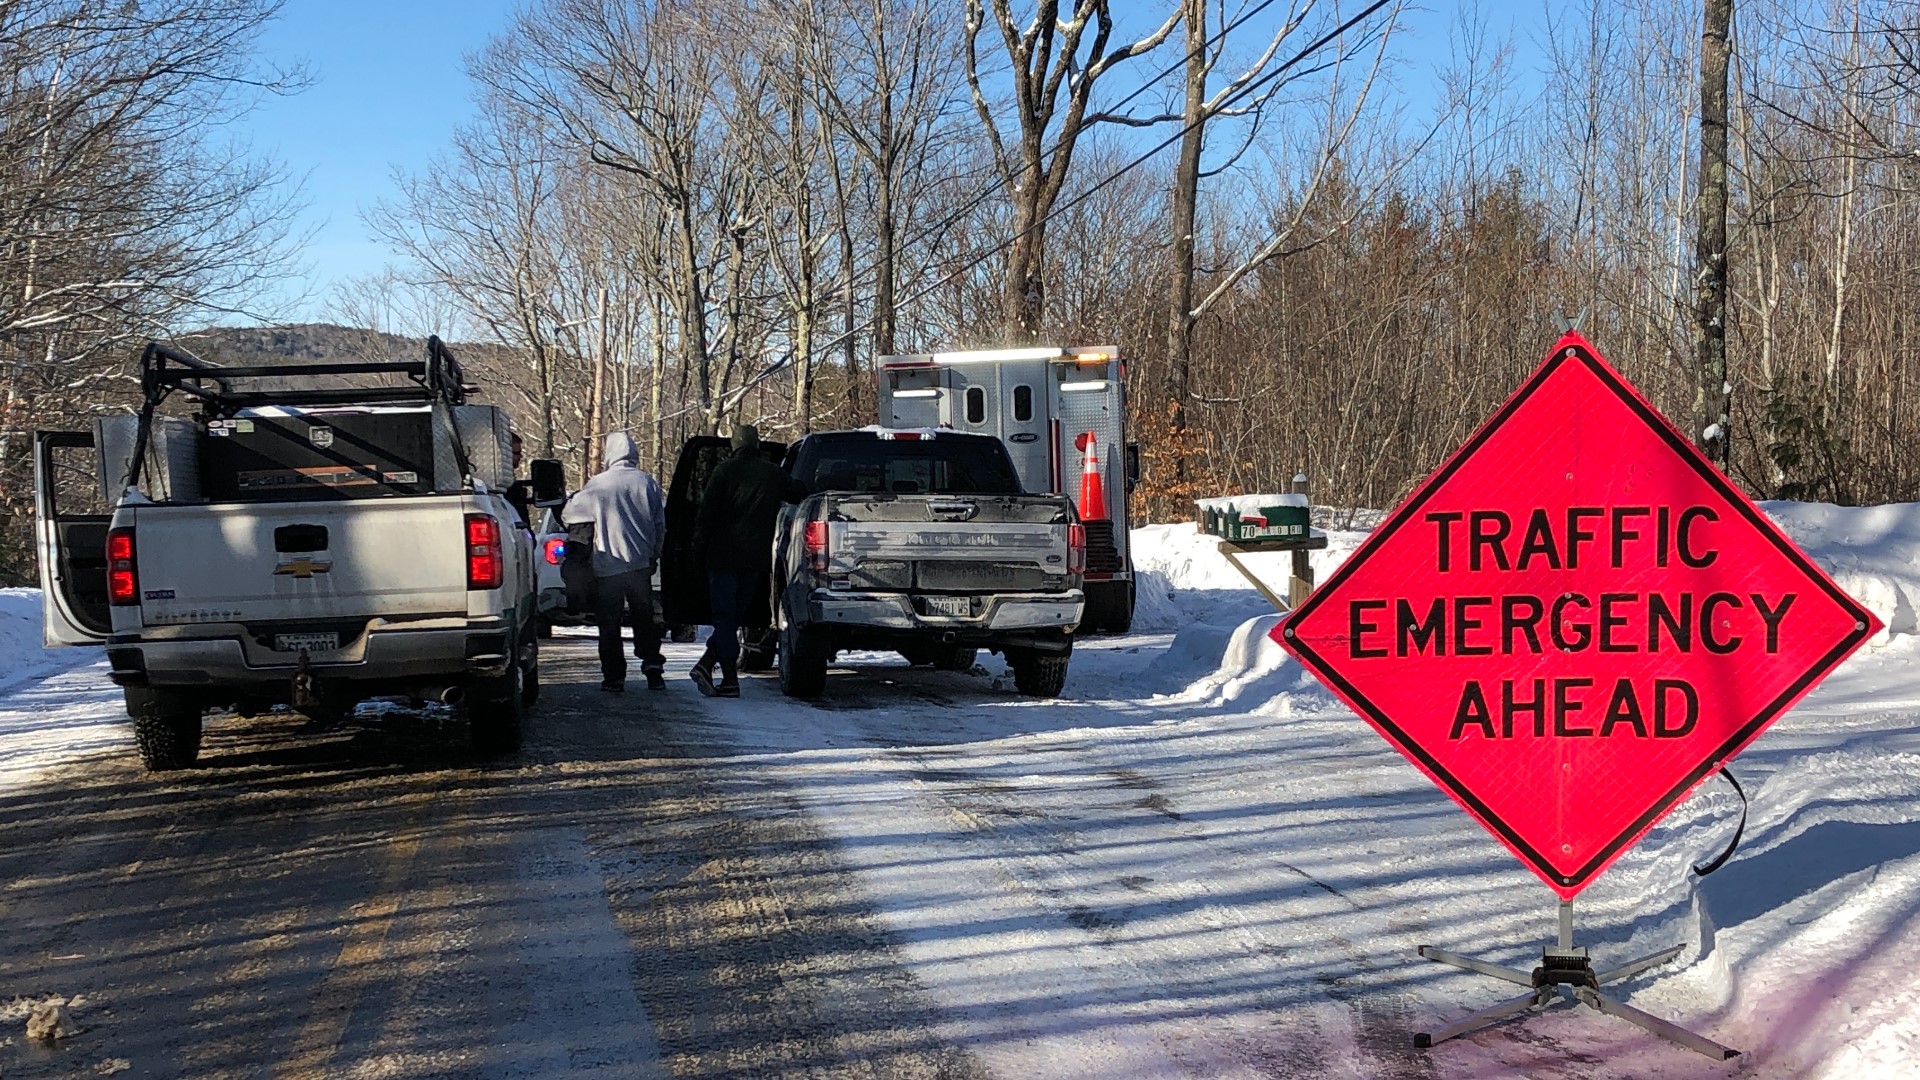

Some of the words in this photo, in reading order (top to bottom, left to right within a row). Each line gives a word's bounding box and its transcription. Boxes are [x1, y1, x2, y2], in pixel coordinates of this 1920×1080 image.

[1242, 526, 1255, 538] 70
[1426, 506, 1722, 573] TRAFFIC
[1349, 593, 1797, 660] EMERGENCY
[1449, 678, 1699, 740] AHEAD
